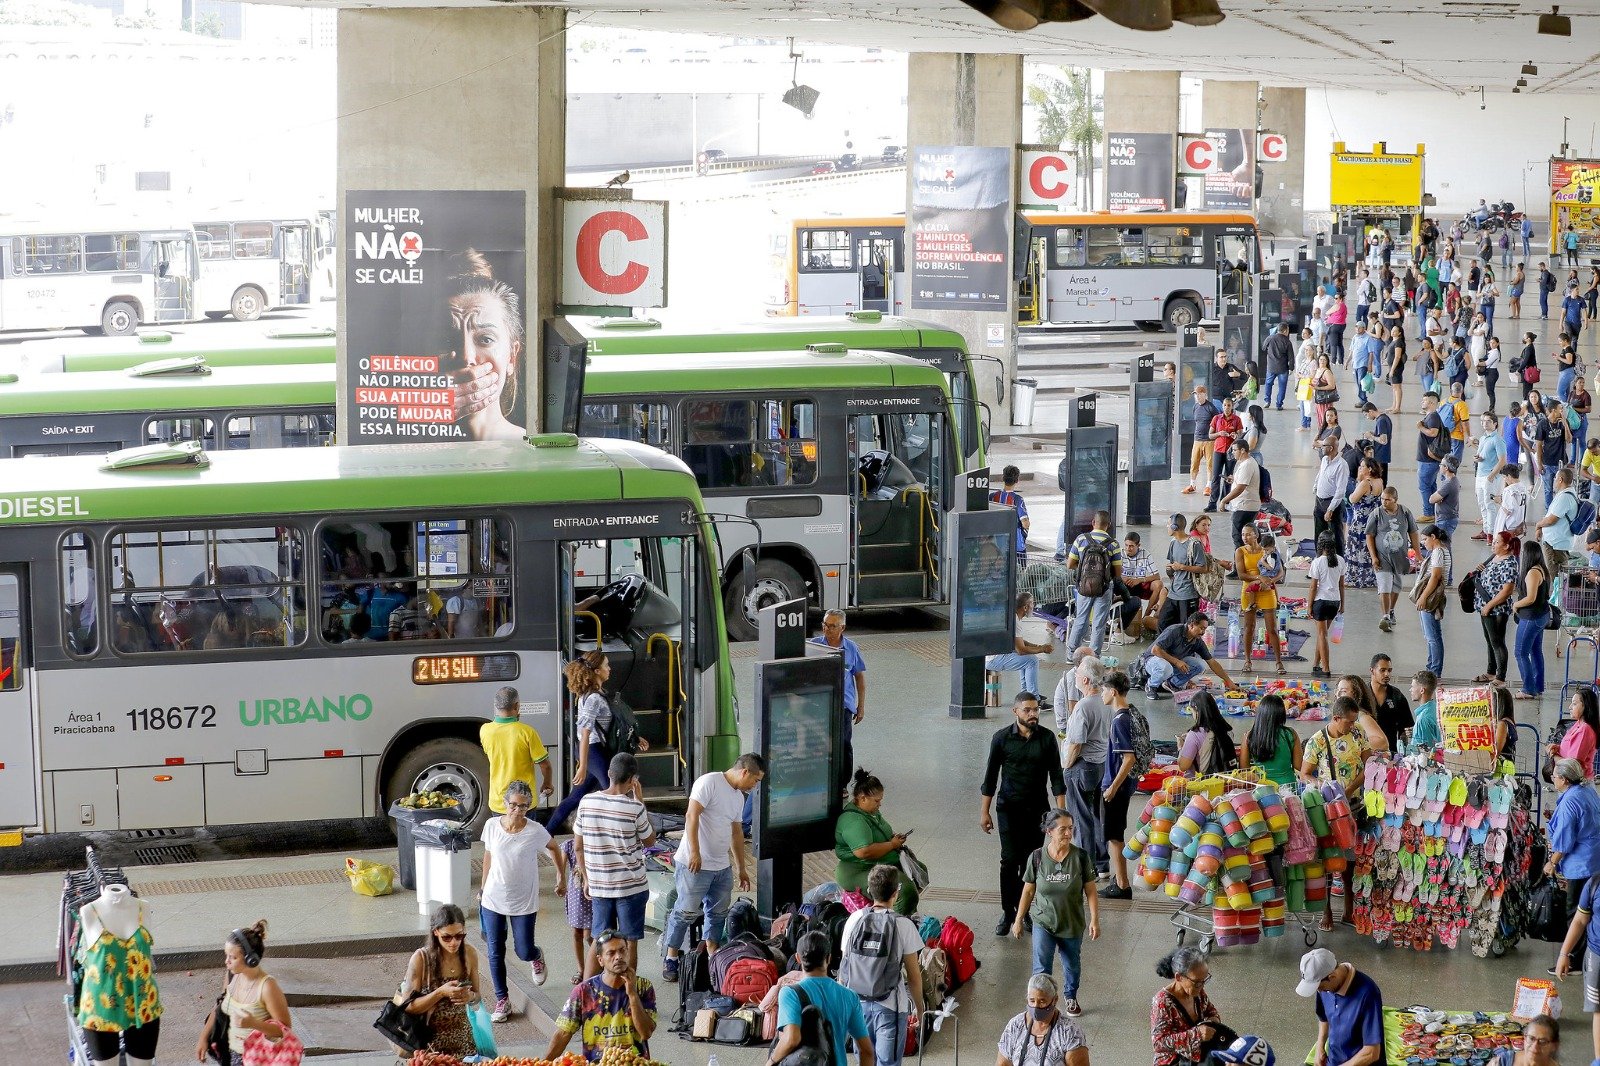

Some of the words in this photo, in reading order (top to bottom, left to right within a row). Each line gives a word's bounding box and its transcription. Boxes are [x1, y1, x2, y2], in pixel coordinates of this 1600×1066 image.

[1263, 137, 1283, 158] C
[1186, 141, 1212, 170] C
[1030, 156, 1069, 199] C
[354, 208, 424, 226] MULHER,
[916, 223, 923, 232] A
[924, 224, 950, 232] CADA
[924, 234, 968, 242] MINUTOS,
[355, 224, 423, 268] NÃO
[576, 211, 650, 294] C
[924, 243, 970, 252] MULHERES
[916, 252, 953, 260] SOFREM
[954, 252, 1002, 262] VIOLÊNCIA
[932, 262, 965, 270] BRASIL.
[355, 269, 376, 284] SE
[379, 268, 424, 284] CALE!
[1070, 274, 1090, 284] Área
[360, 358, 370, 370] O
[372, 356, 435, 372] SILÊNCIO
[360, 372, 390, 386] NÃO
[393, 376, 458, 388] PROTEGE.
[360, 390, 388, 403] SUA
[390, 391, 449, 404] ATITUDE
[1078, 400, 1084, 410] C
[1085, 400, 1095, 410] 03
[360, 407, 397, 419] PODE
[400, 408, 452, 420] MUDAR
[42, 426, 68, 435] SAÍDA
[75, 426, 95, 434] EXIT
[360, 423, 393, 435] ESSA
[396, 422, 467, 437] HISTÓRIA.
[968, 478, 974, 488] C
[976, 478, 988, 488] 02
[0, 496, 90, 518] DIESEL
[553, 518, 600, 528] ENTRADA
[606, 515, 659, 526] ENTRANCE
[777, 613, 786, 628] C
[788, 612, 804, 627] 01
[452, 656, 479, 678] SUL
[68, 710, 93, 723] Área
[96, 712, 102, 722] 1
[239, 693, 372, 727] URBANO
[126, 704, 217, 731] 118672
[53, 724, 116, 735] Piracicabana
[594, 1024, 636, 1036] Rakute
